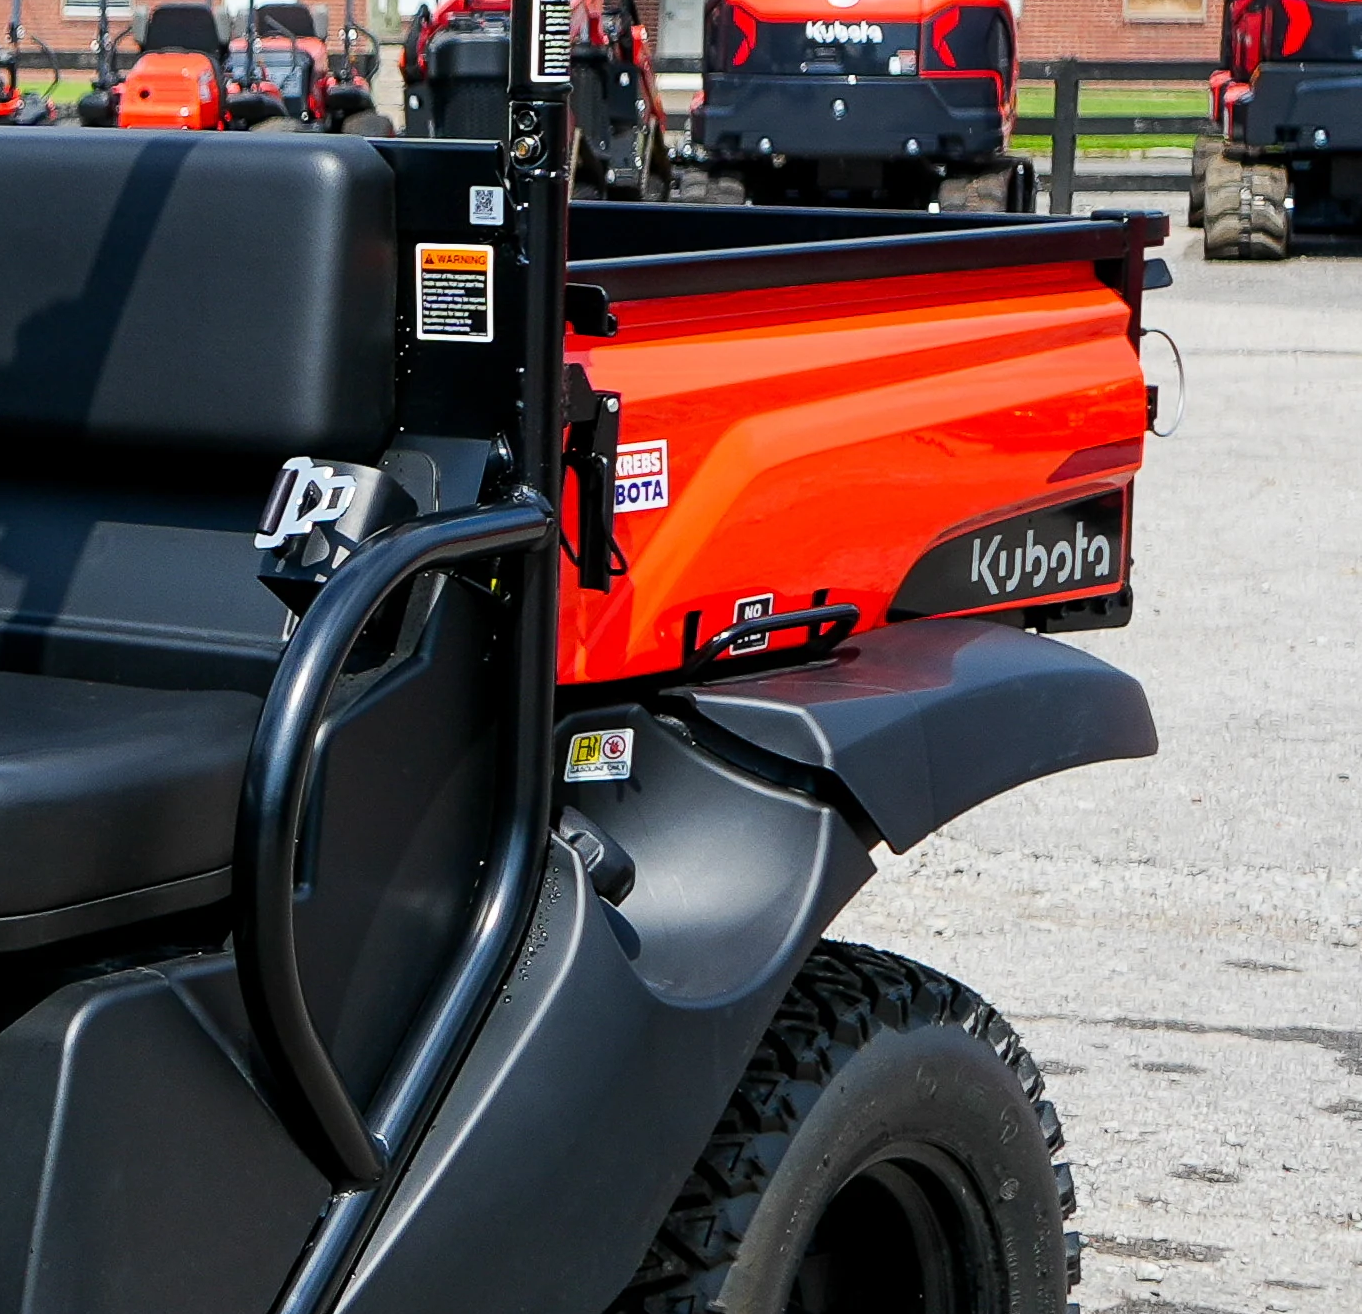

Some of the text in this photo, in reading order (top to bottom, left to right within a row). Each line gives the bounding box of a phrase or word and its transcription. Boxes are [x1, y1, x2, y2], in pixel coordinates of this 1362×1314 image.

[805, 20, 883, 44] Kubota
[436, 254, 487, 266] WARNING
[615, 479, 664, 506] BOTA
[969, 521, 1111, 596] Kubota
[744, 603, 763, 620] NO
